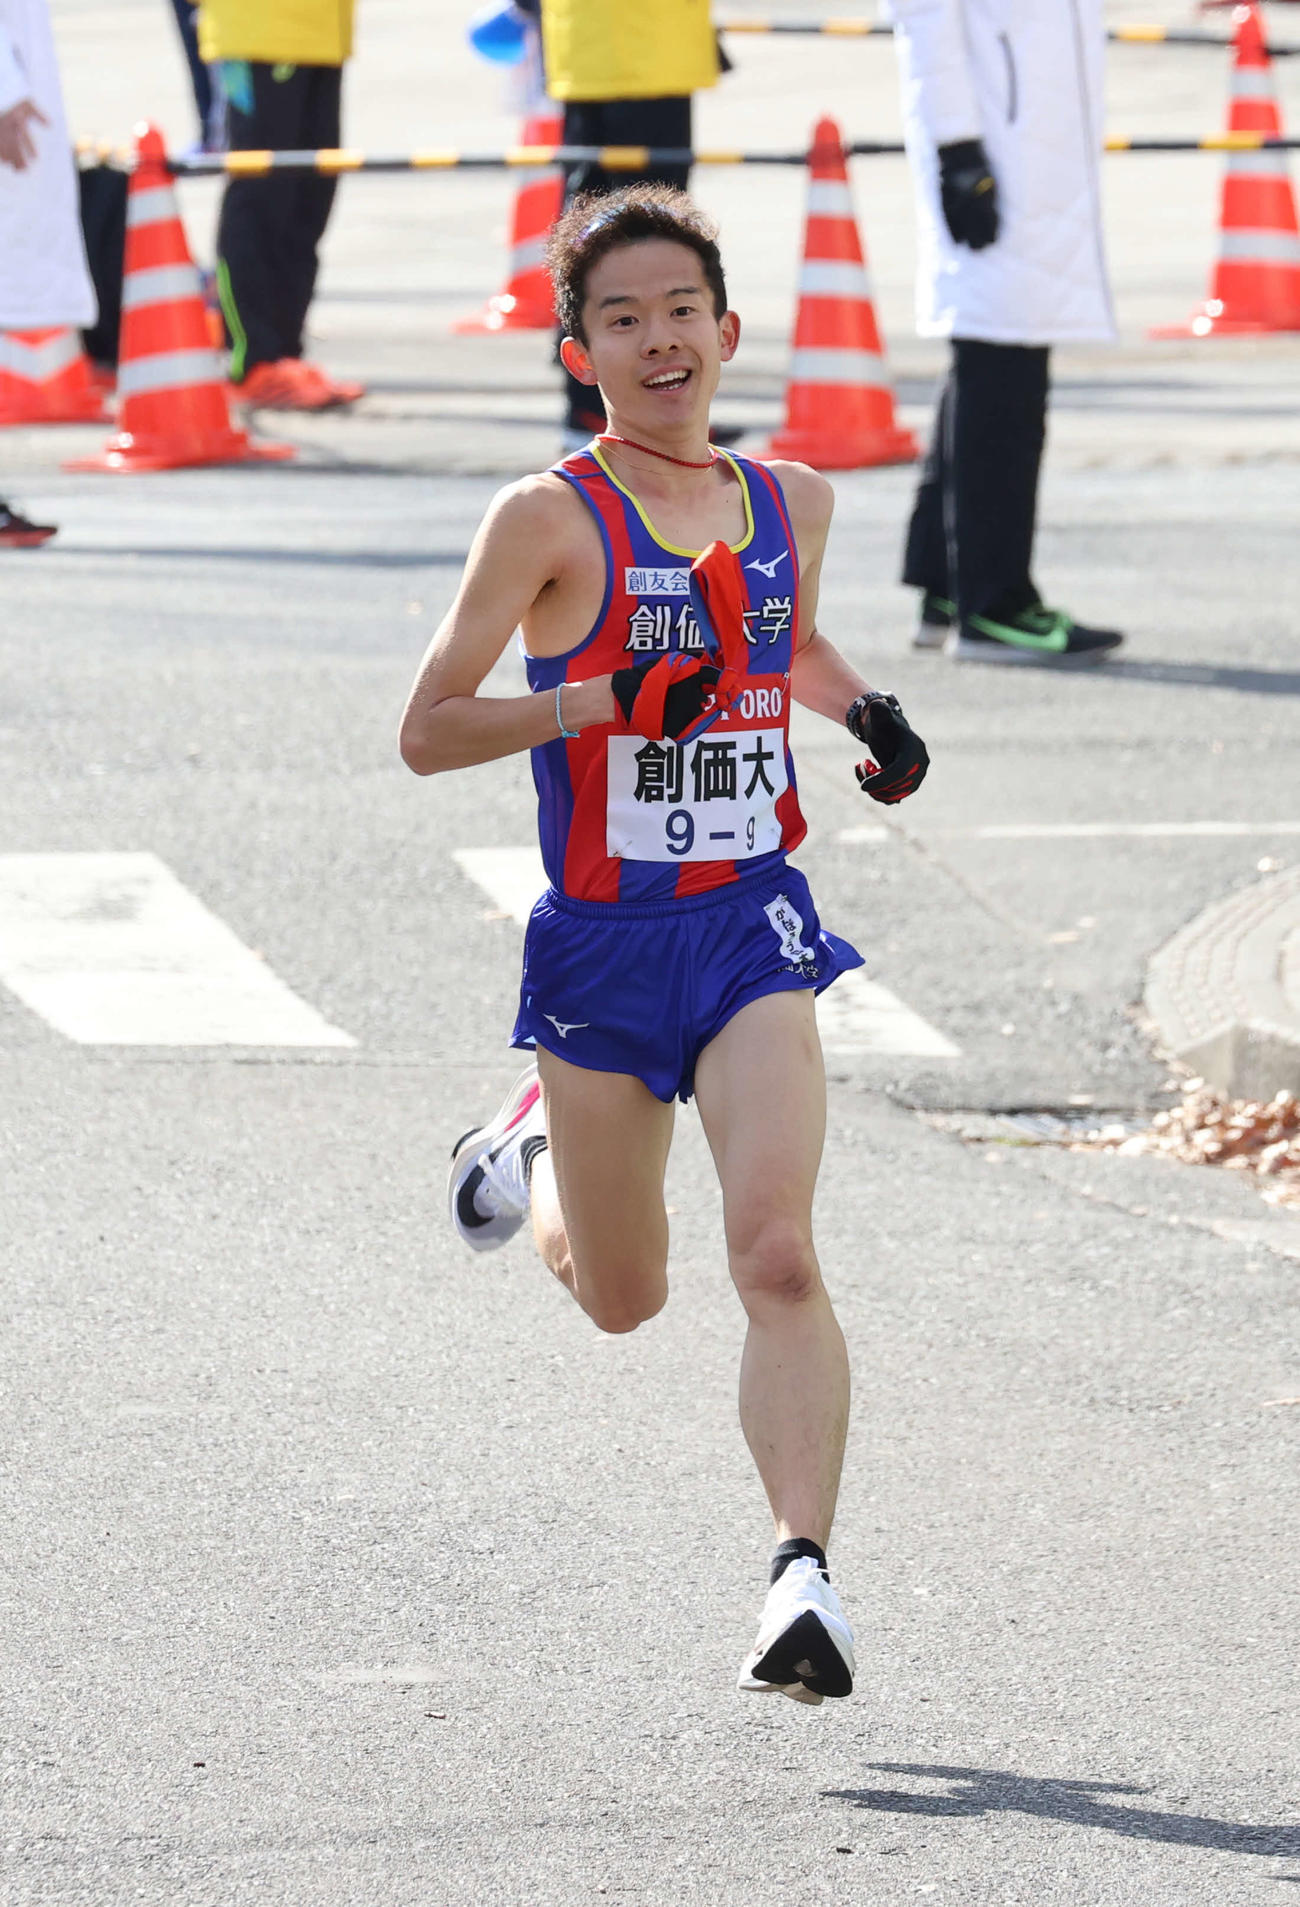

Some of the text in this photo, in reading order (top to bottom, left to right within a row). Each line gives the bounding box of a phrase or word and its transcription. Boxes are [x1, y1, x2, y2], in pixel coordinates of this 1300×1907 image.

[628, 571, 688, 592] 創友会
[634, 736, 775, 804] 創価大
